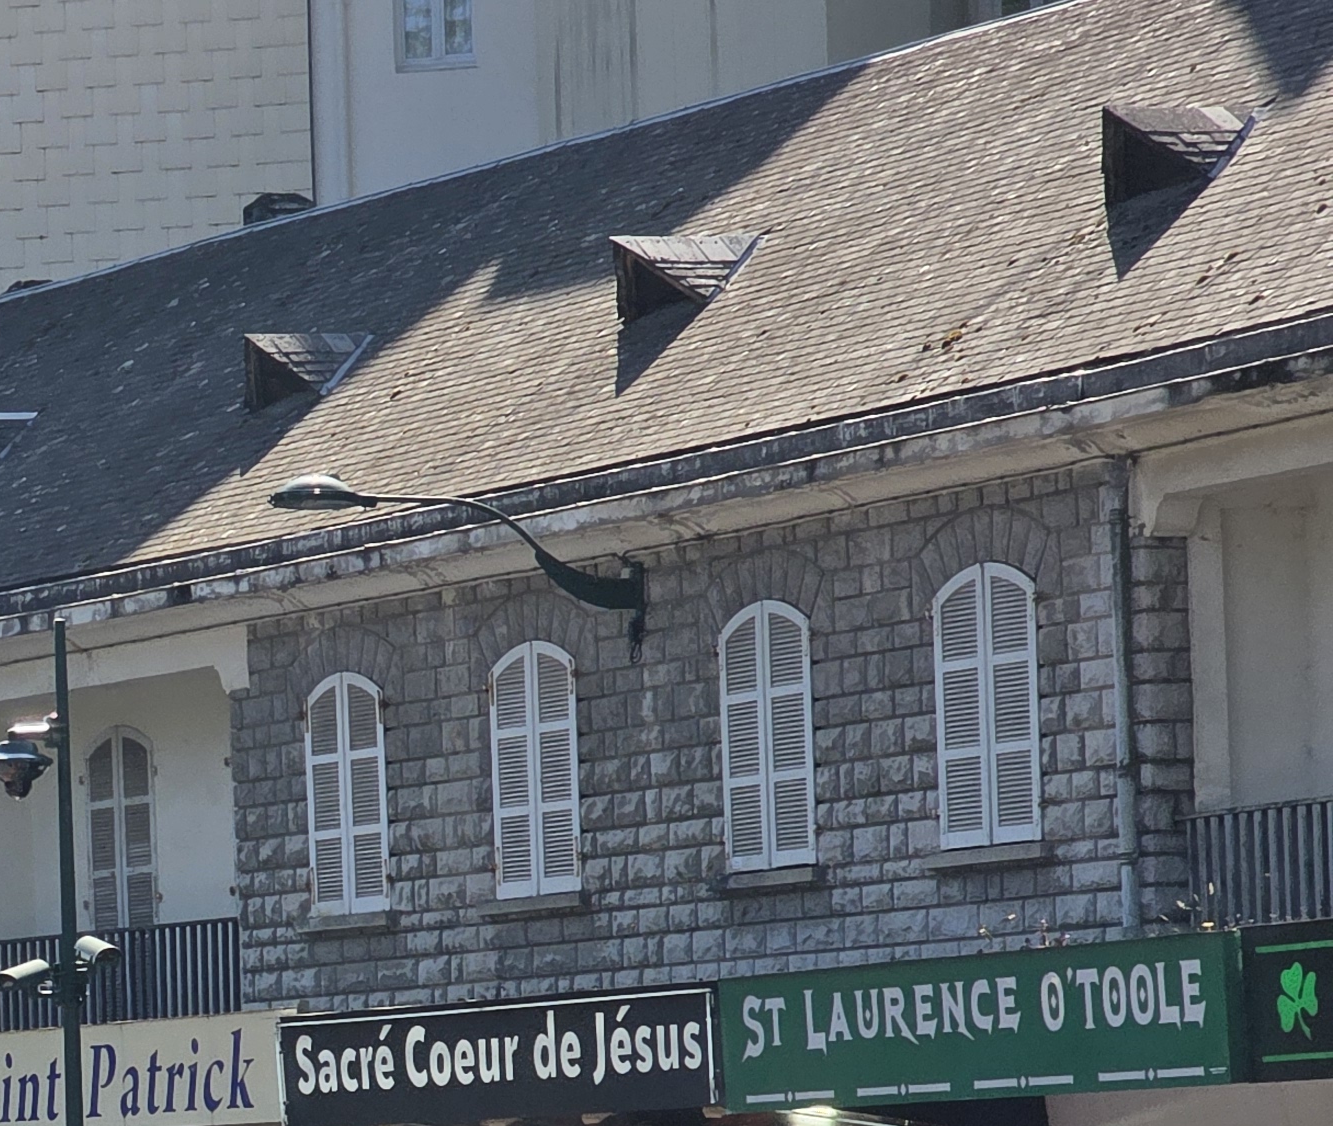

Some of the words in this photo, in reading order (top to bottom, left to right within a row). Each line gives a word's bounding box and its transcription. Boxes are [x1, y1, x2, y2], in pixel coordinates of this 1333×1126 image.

[296, 1023, 397, 1095] Sacré
[405, 1024, 520, 1088] Coeur
[534, 1009, 582, 1080] de
[593, 1004, 703, 1086] Jésus
[742, 994, 787, 1060] ST
[803, 975, 1021, 1056] LAURENCE
[1040, 959, 1206, 1034] O'TOOLE
[85, 1028, 255, 1119] Patrick
